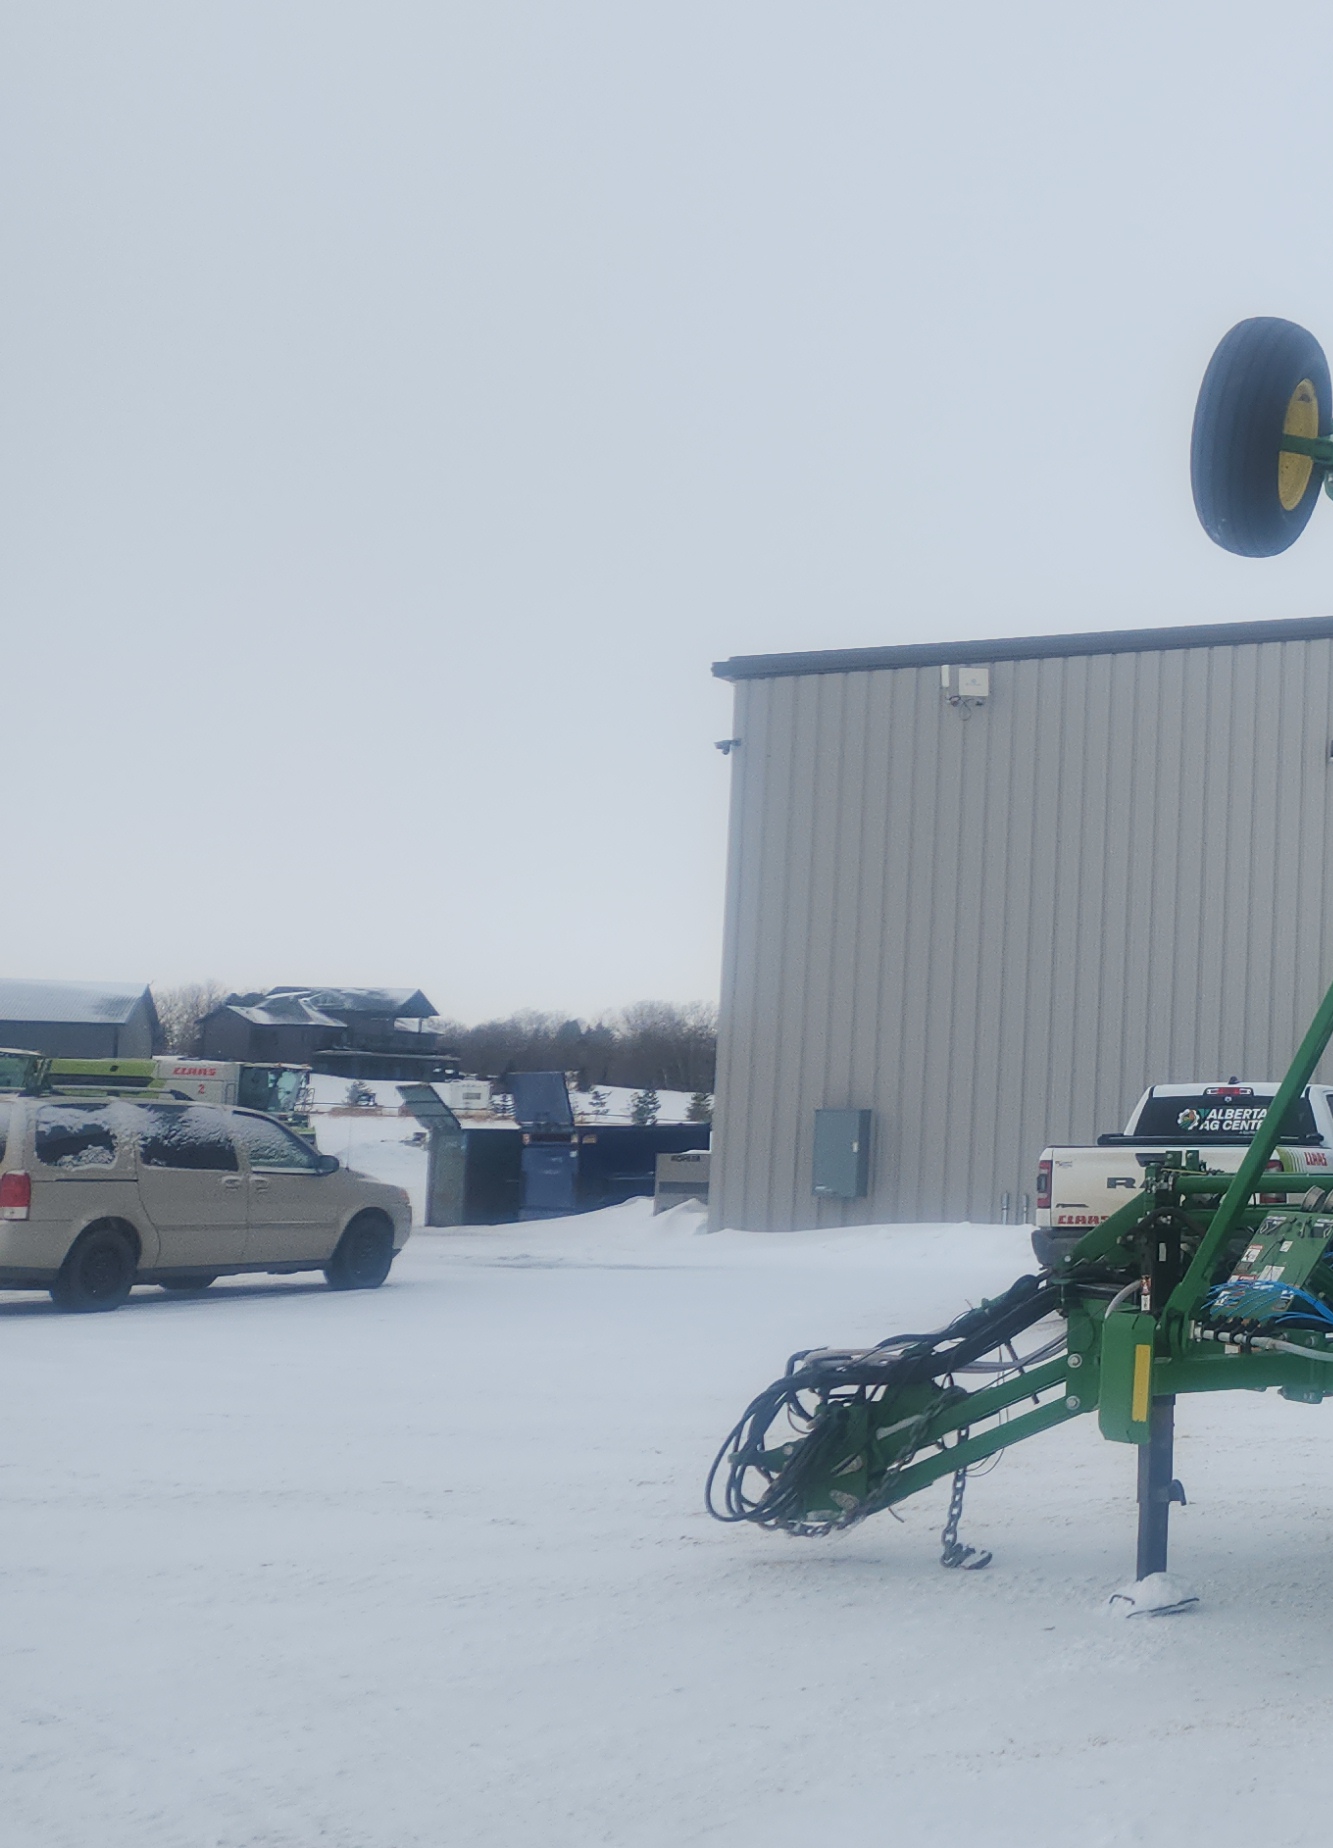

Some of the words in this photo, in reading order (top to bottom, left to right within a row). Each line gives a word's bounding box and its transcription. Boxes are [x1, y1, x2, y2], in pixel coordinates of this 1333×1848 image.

[173, 1067, 217, 1076] CLAAS
[198, 1083, 205, 1094] 2
[1206, 1108, 1268, 1120] ALBERTA
[1198, 1119, 1220, 1131] AG
[1222, 1119, 1264, 1131] CENT
